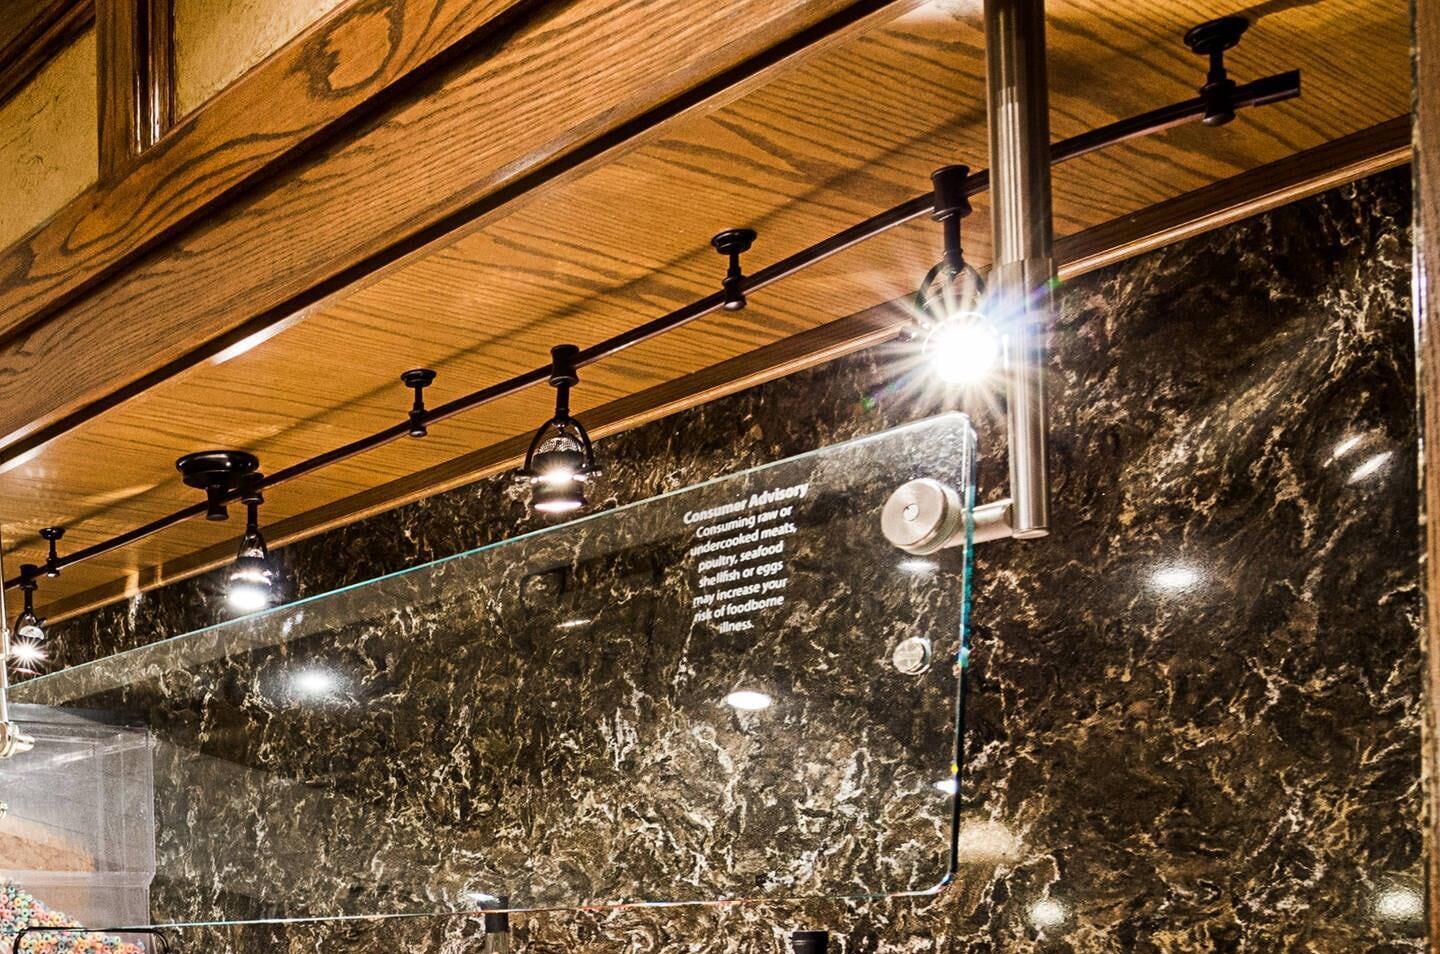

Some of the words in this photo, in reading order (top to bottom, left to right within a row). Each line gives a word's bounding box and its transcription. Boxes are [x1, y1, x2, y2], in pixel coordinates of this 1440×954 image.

[683, 499, 748, 525] Consumer
[748, 483, 809, 508] Advisory
[696, 515, 756, 538] Consuming
[757, 510, 778, 524] raw
[779, 505, 794, 517] or
[690, 529, 759, 557] undercooked
[760, 522, 798, 539] meats,
[698, 554, 738, 573] poultry,
[740, 540, 784, 562] seafood
[698, 569, 740, 588] shellfish
[742, 567, 755, 578] or
[756, 561, 784, 577] eggs
[692, 593, 715, 609] may
[716, 583, 761, 600] increase
[761, 578, 788, 595] your
[693, 608, 713, 623] risk
[714, 604, 726, 619] of
[726, 595, 785, 615] foodborne
[719, 620, 755, 634] illness.
